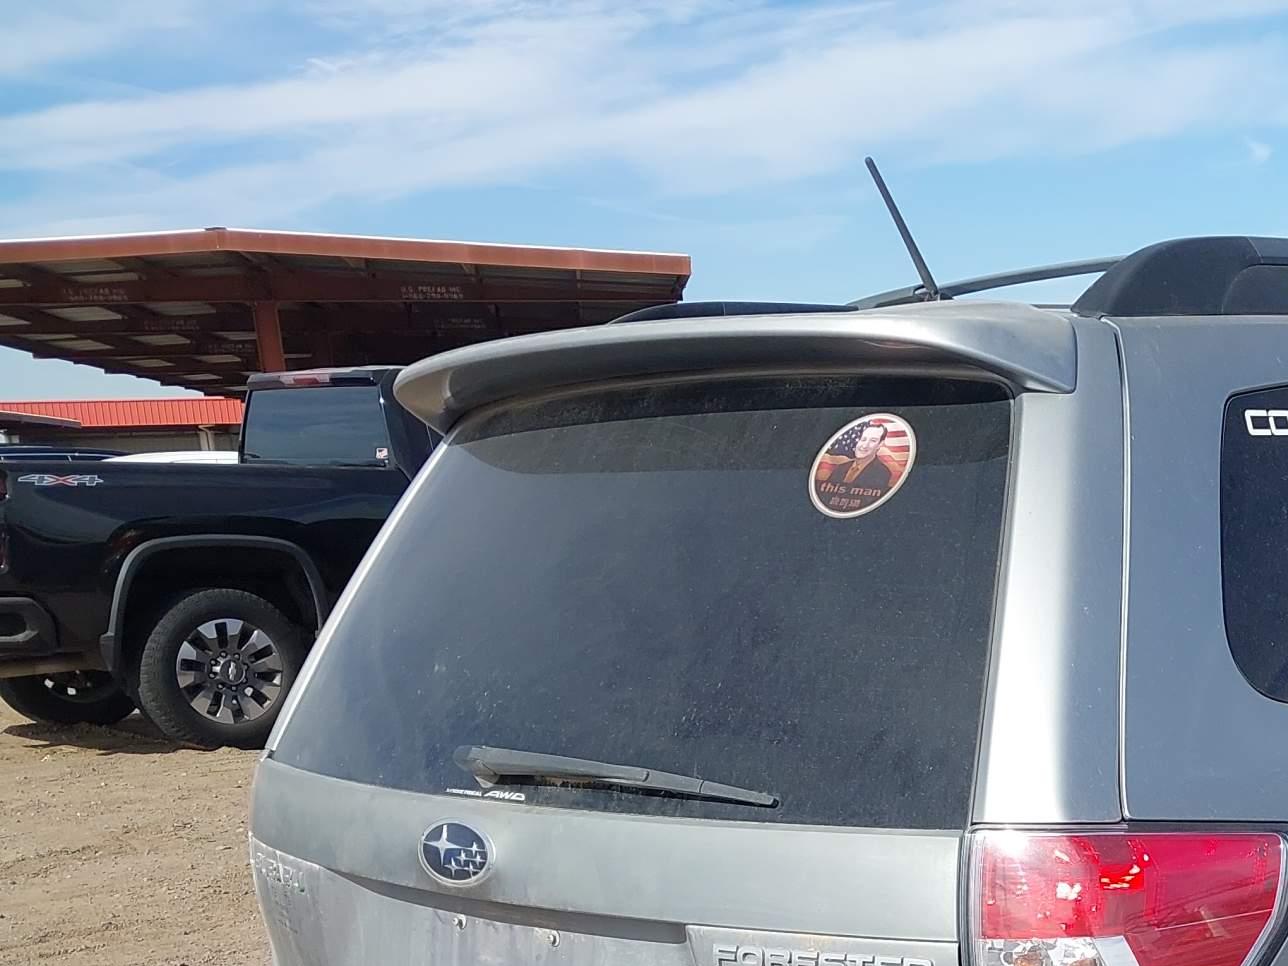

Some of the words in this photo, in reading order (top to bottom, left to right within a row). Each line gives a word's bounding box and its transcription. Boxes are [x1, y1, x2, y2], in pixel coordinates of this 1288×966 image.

[820, 482, 846, 494] this
[850, 487, 881, 497] man
[484, 790, 526, 801] AWD
